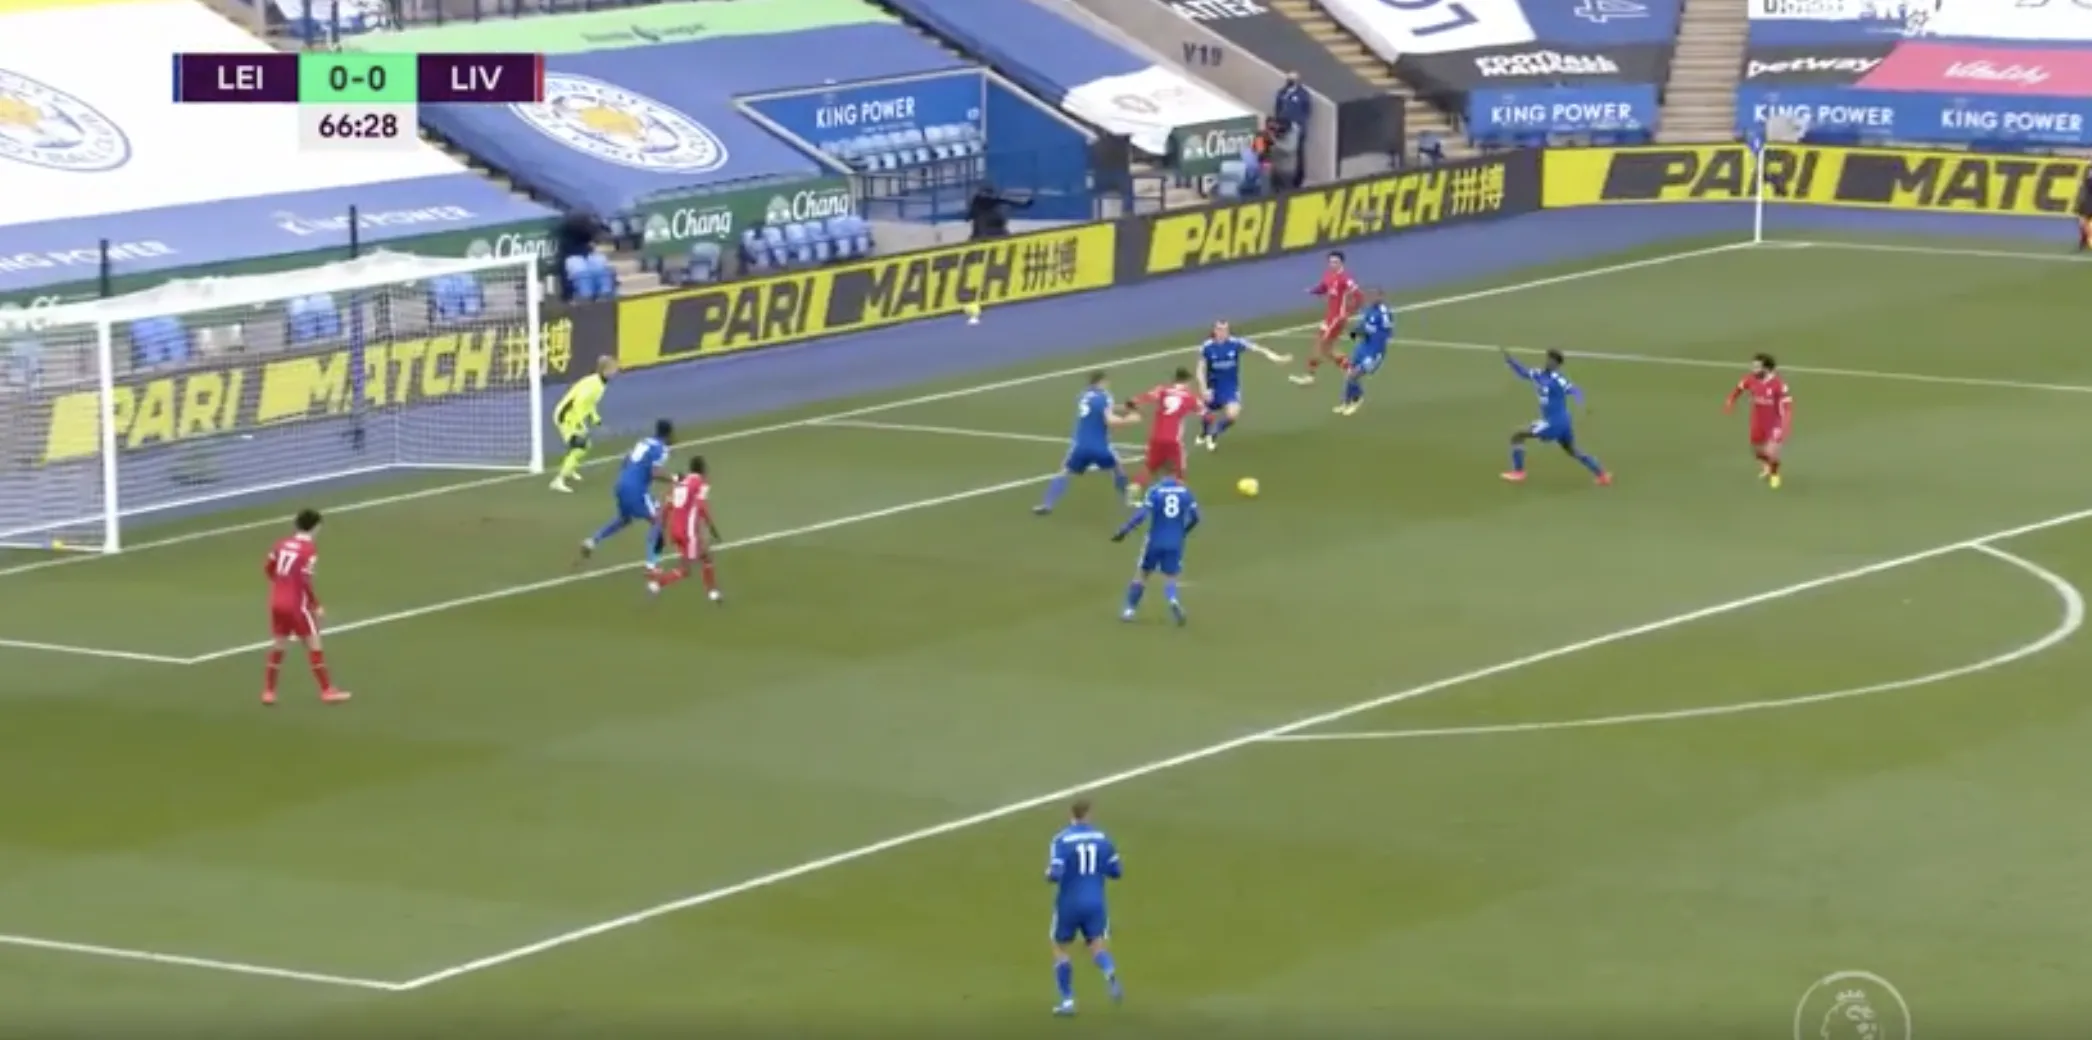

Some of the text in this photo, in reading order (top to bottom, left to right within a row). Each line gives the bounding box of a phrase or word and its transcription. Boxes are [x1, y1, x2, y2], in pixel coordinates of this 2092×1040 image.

[816, 104, 857, 129] KING
[862, 96, 916, 123] POWER
[1491, 102, 1634, 123] KING POWER
[1817, 104, 1895, 126] POWER
[1942, 109, 2083, 132] KING POWER
[1600, 149, 2092, 213] PARI MATC
[793, 188, 850, 219] Chang
[671, 205, 733, 241] Chang
[1147, 200, 1276, 274] PARI
[1282, 169, 1449, 249] MATCH
[659, 278, 813, 356] PARI
[825, 245, 1018, 328] MATCH
[1164, 494, 1180, 518] 8
[276, 549, 298, 576] 17
[1075, 843, 1098, 875] 11
